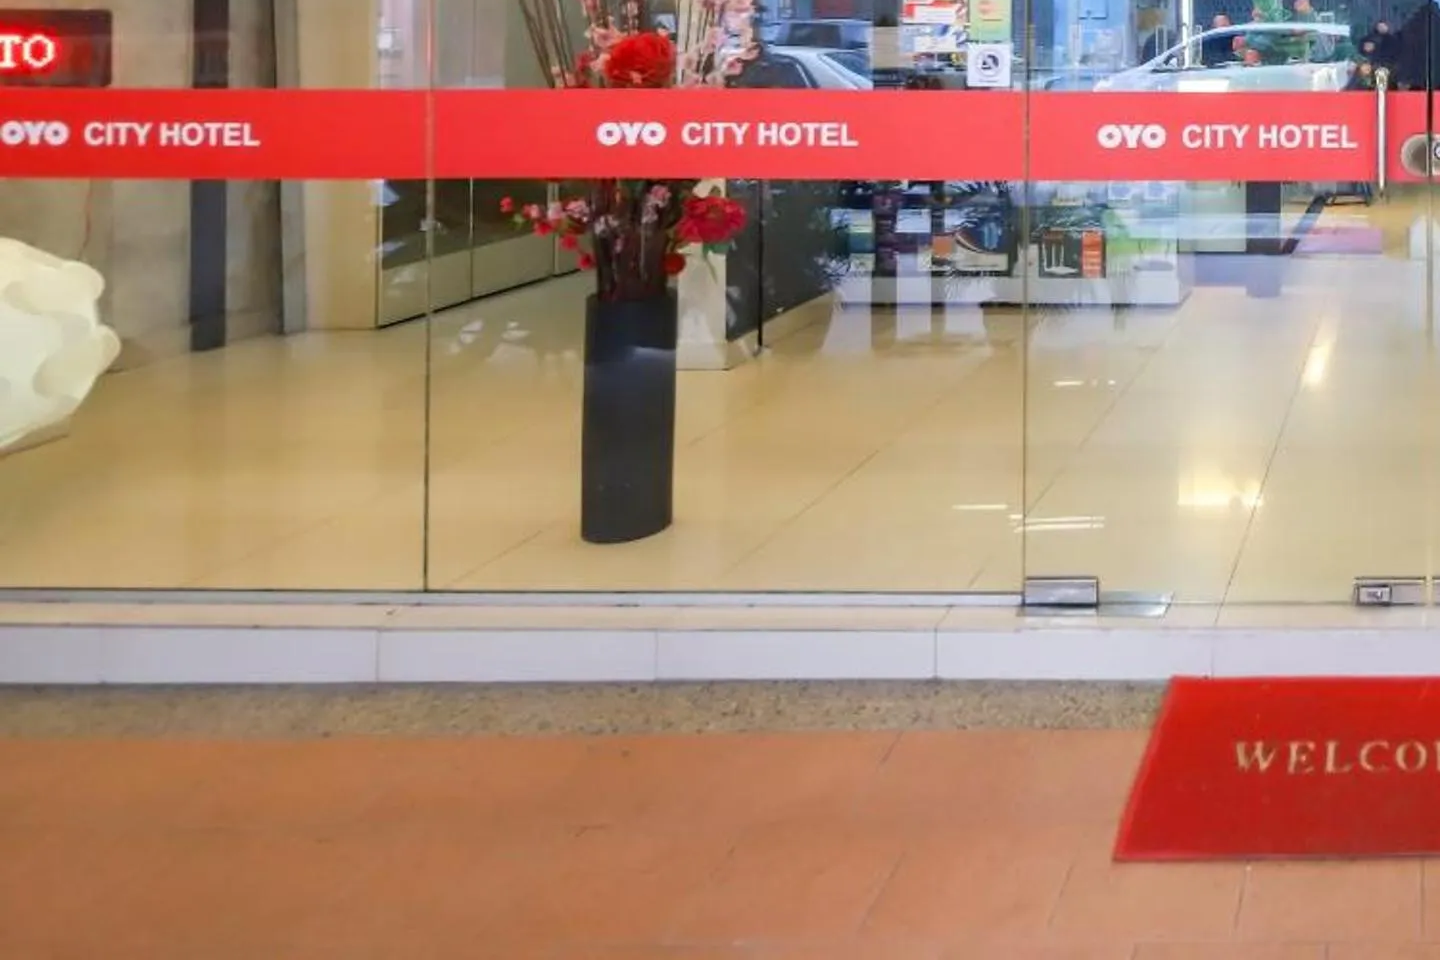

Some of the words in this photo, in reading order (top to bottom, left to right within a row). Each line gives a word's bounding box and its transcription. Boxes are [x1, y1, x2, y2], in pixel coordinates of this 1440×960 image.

[0, 120, 70, 146] OYO
[84, 121, 152, 146] CITY
[160, 121, 260, 146] HOTEL
[596, 120, 668, 147] OYO
[680, 121, 751, 147] CITY
[757, 121, 859, 147] HOTEL
[1095, 123, 1169, 150] OYO
[1180, 123, 1252, 150] CITY
[1258, 123, 1359, 150] HOTEL
